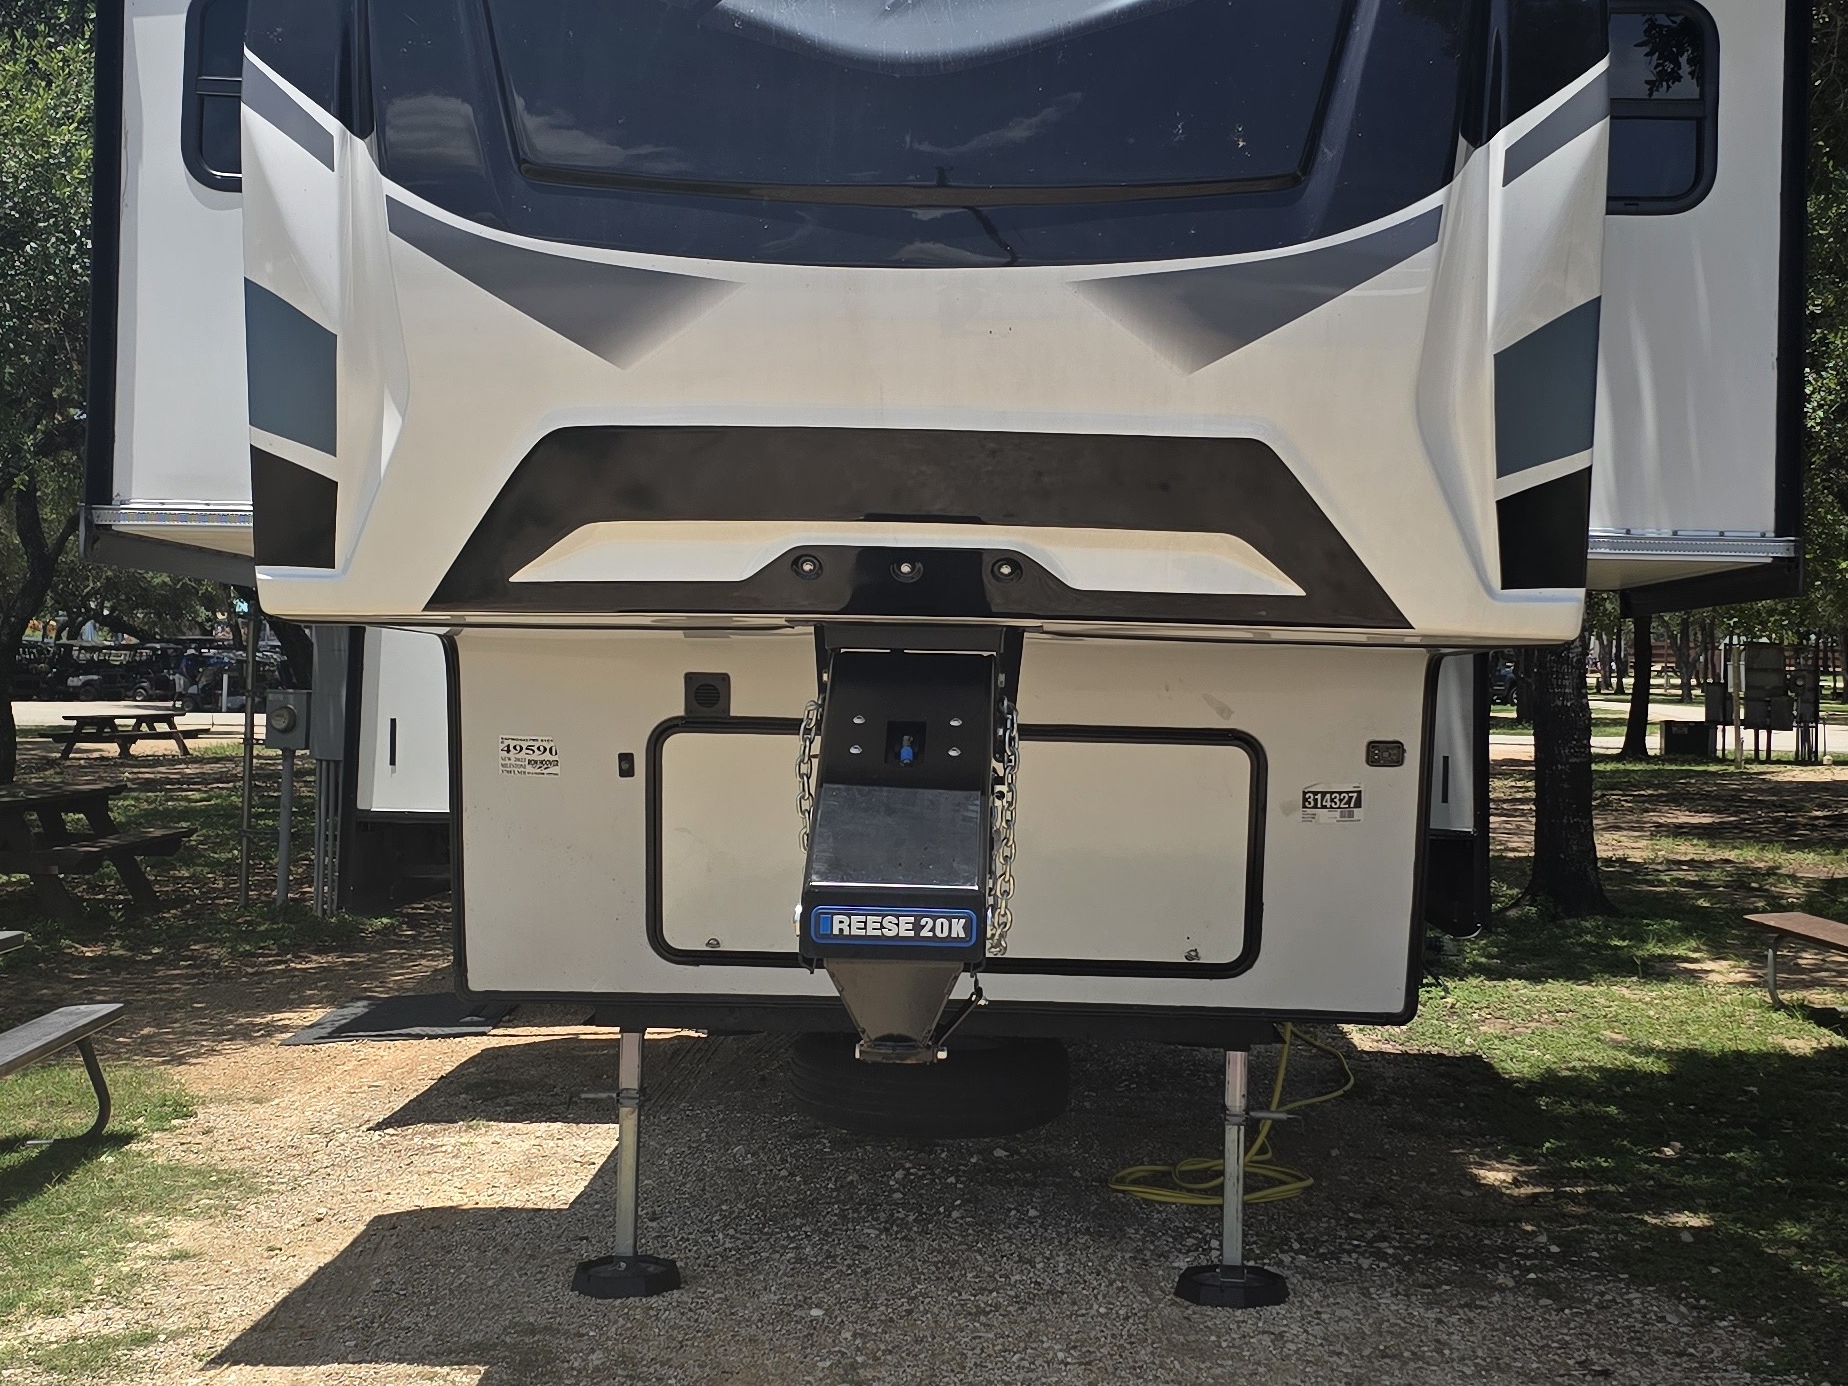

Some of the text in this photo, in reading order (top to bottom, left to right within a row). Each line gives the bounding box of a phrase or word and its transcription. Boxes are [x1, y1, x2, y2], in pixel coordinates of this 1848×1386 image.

[1305, 793, 1358, 808] 314327
[832, 915, 966, 938] REESE 20K
